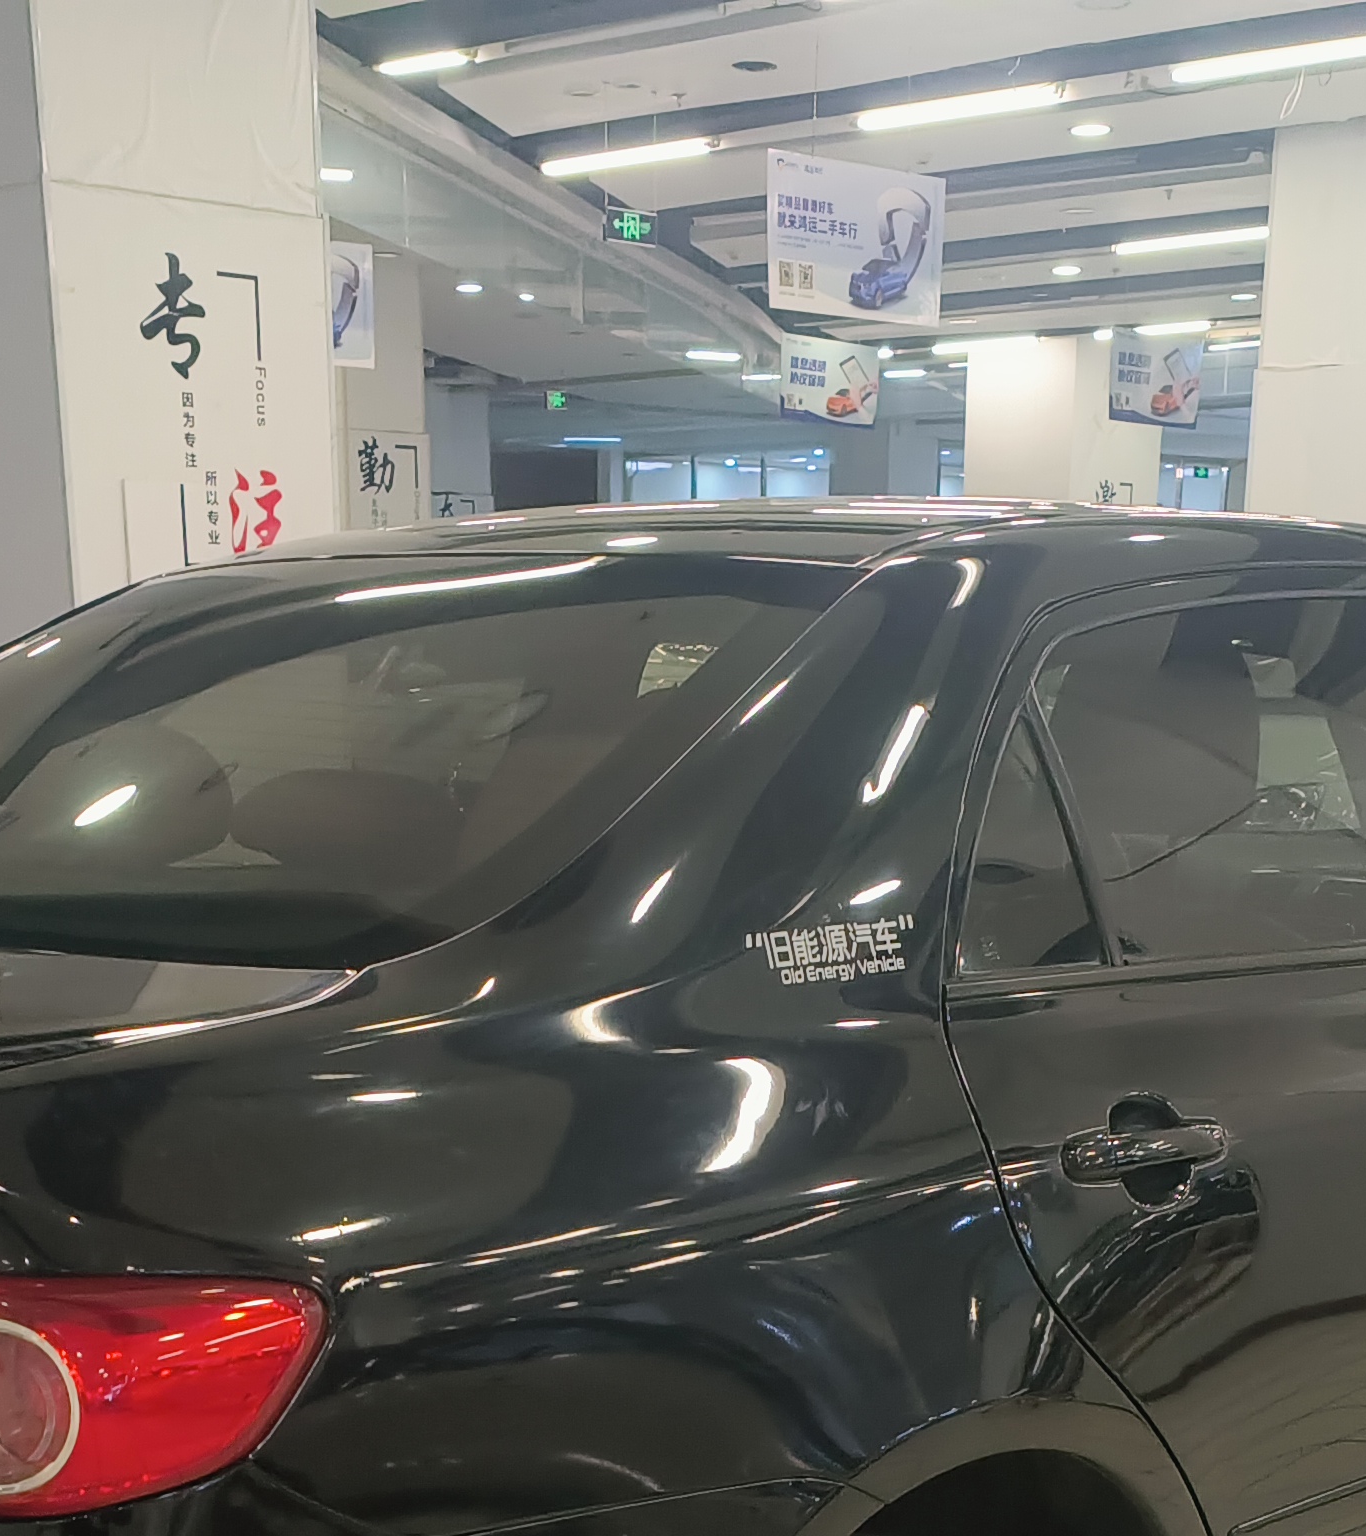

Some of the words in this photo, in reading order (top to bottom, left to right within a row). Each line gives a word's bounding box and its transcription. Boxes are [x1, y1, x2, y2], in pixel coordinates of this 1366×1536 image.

[140, 252, 206, 379] 专
[181, 391, 197, 468] 因为专注
[254, 365, 267, 427] Focus
[358, 436, 395, 495] 勤
[204, 470, 221, 545] 所以专业
[229, 468, 283, 555] 注
[780, 967, 805, 985] Old
[806, 962, 856, 982] Energy
[856, 955, 906, 975] Vehicle
